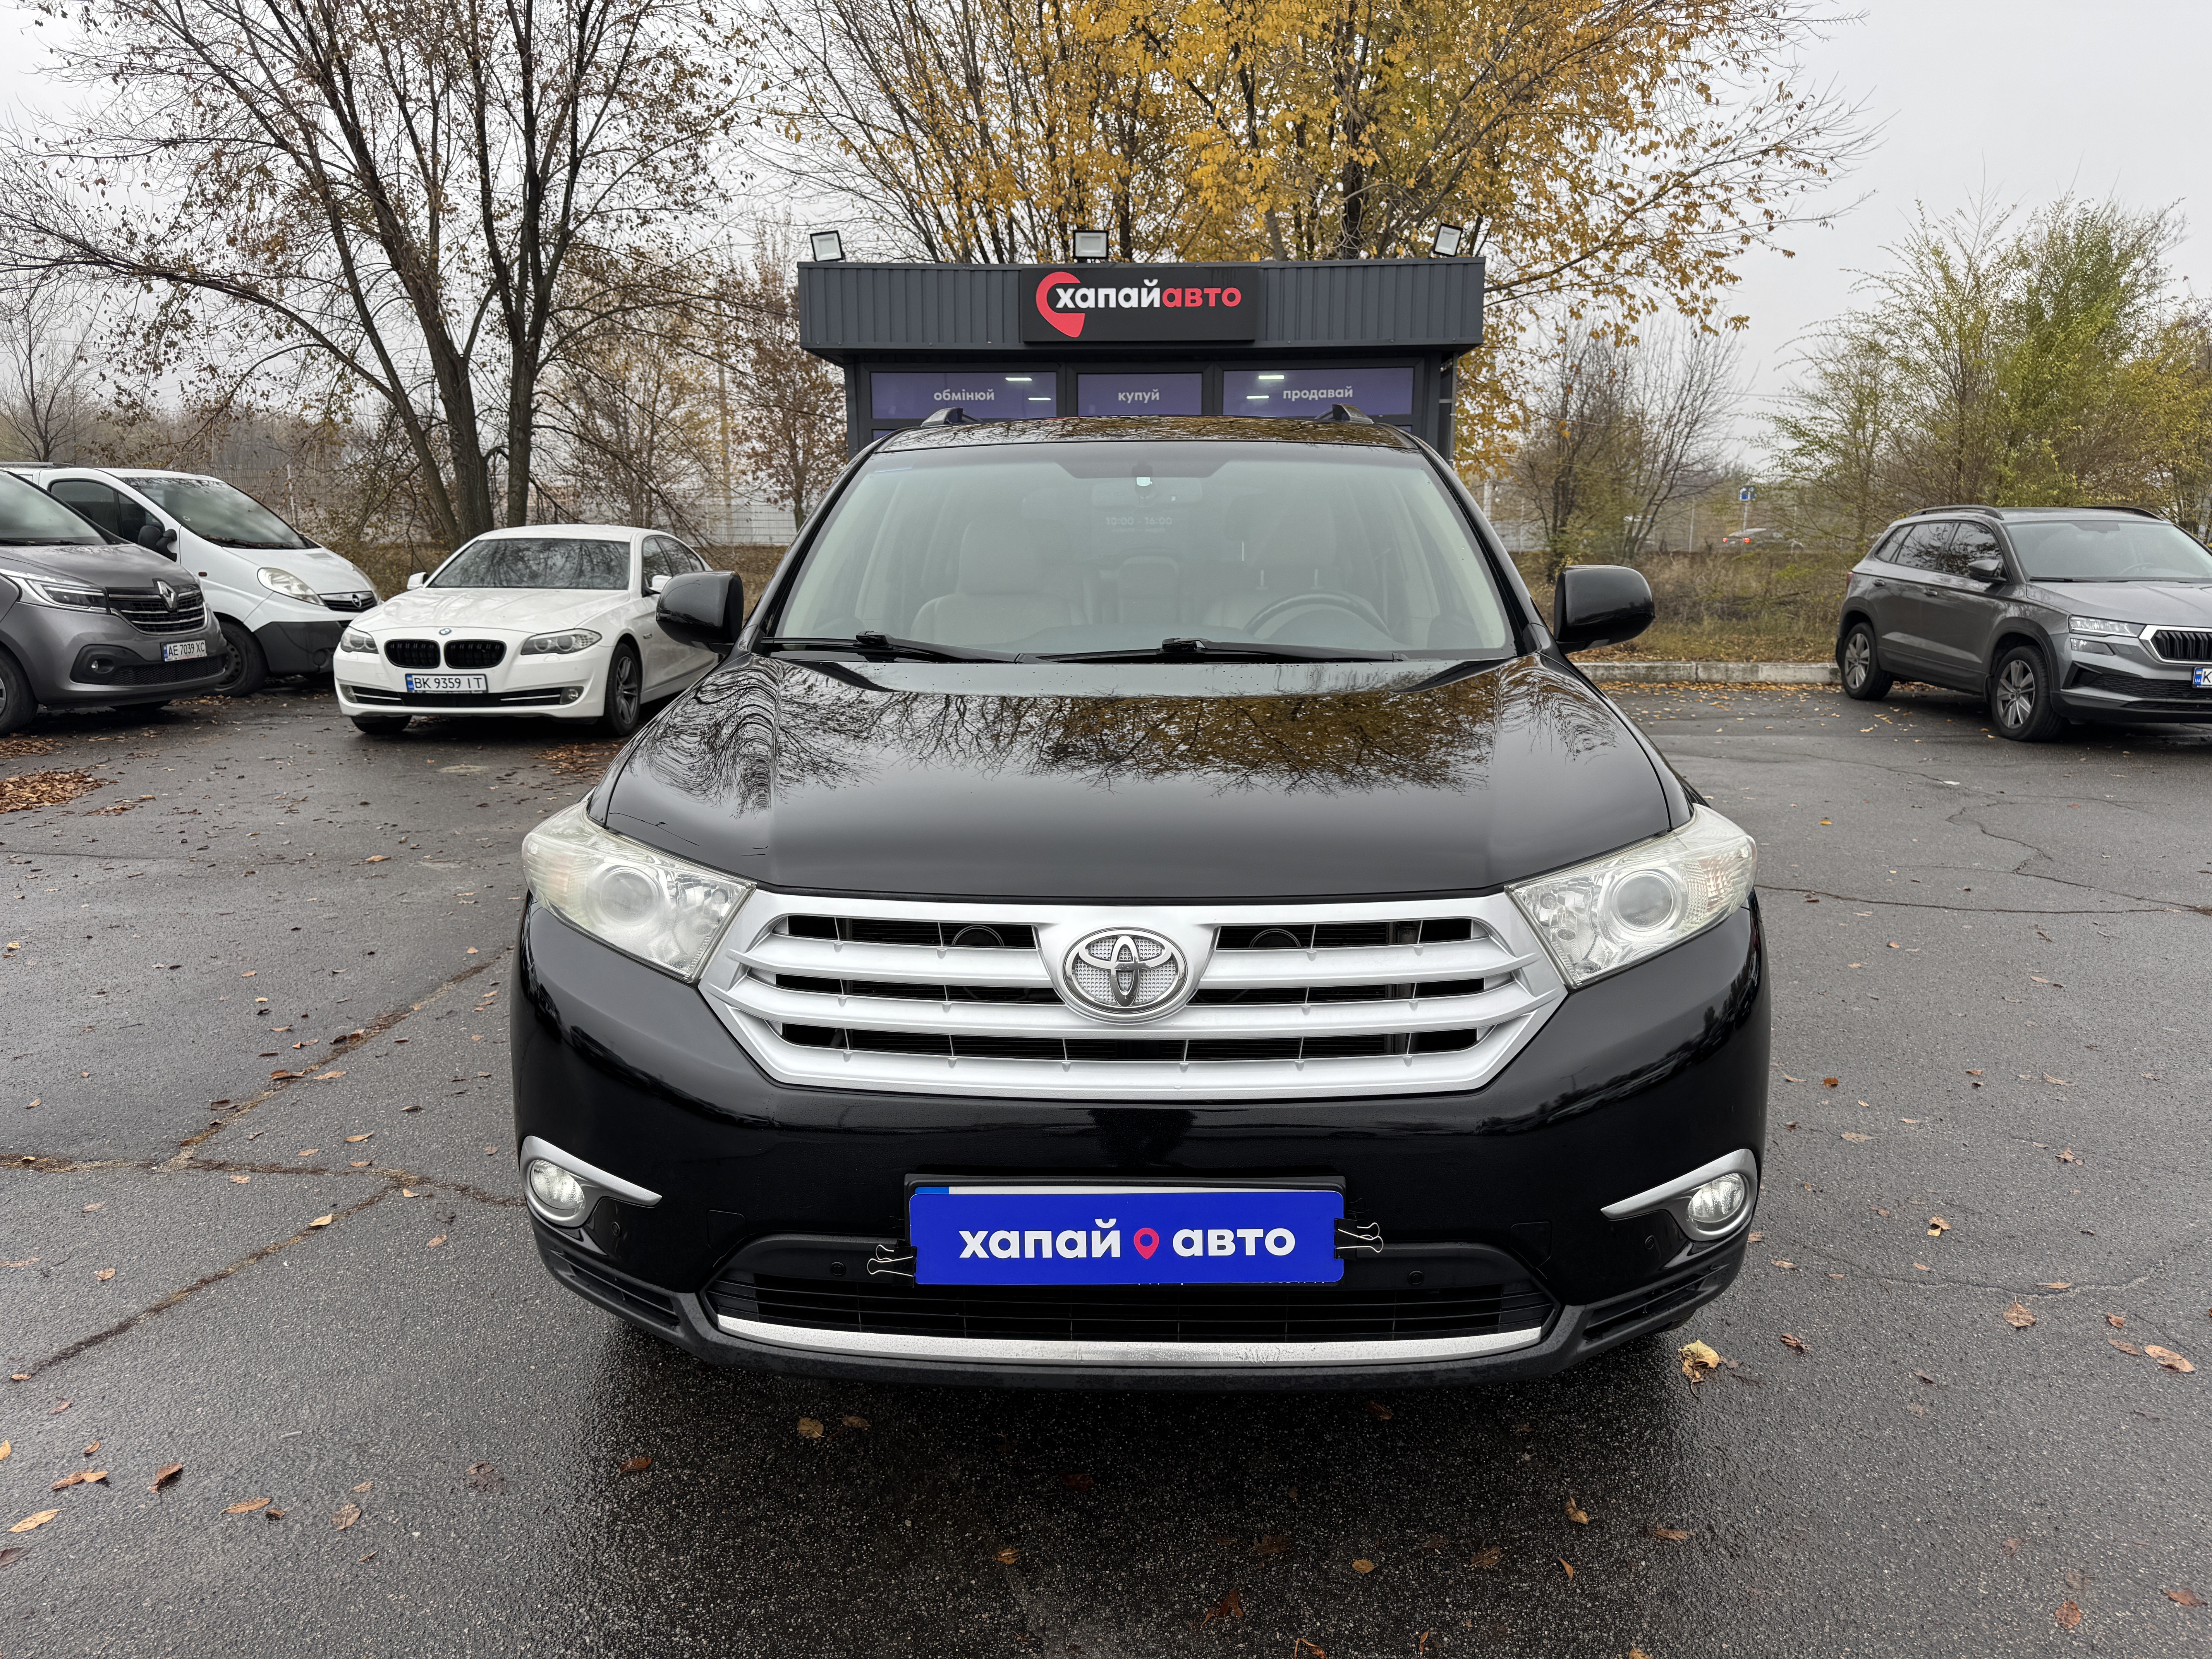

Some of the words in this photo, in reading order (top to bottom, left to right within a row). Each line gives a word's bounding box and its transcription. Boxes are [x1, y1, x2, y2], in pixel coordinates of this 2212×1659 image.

[934, 389, 994, 401] обмінюй
[1118, 388, 1159, 404] купуй
[1283, 386, 1353, 402] продавай
[1106, 517, 1134, 525] 10:00
[168, 645, 178, 656] AE
[180, 643, 194, 655] 7039
[196, 642, 205, 653] XC
[414, 678, 431, 689] BK
[434, 678, 461, 689] 9359
[467, 678, 483, 689] IT
[958, 1218, 1121, 1259] хапай
[1173, 1228, 1296, 1257] авто
